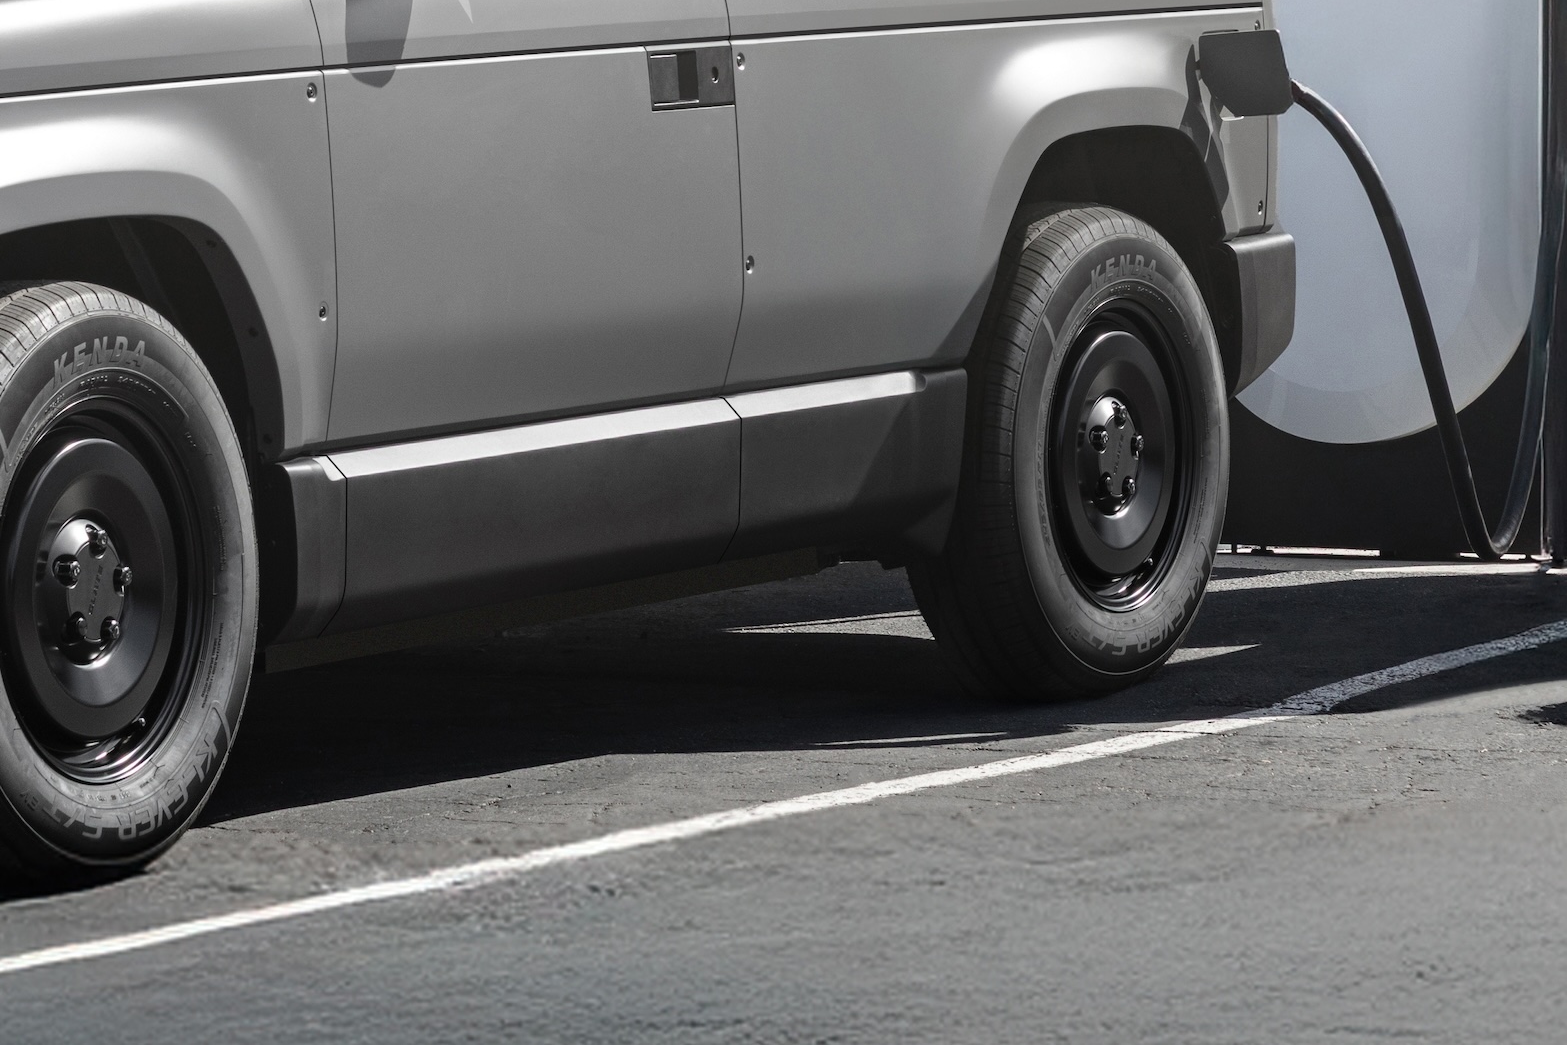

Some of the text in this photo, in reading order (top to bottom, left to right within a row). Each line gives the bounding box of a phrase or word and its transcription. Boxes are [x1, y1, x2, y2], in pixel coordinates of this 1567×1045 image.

[1090, 254, 1157, 289] KENDA
[53, 336, 146, 387] KENDA
[1135, 562, 1204, 654] KLEVER
[116, 733, 219, 840] KLEVER
[41, 795, 103, 840] S/T
